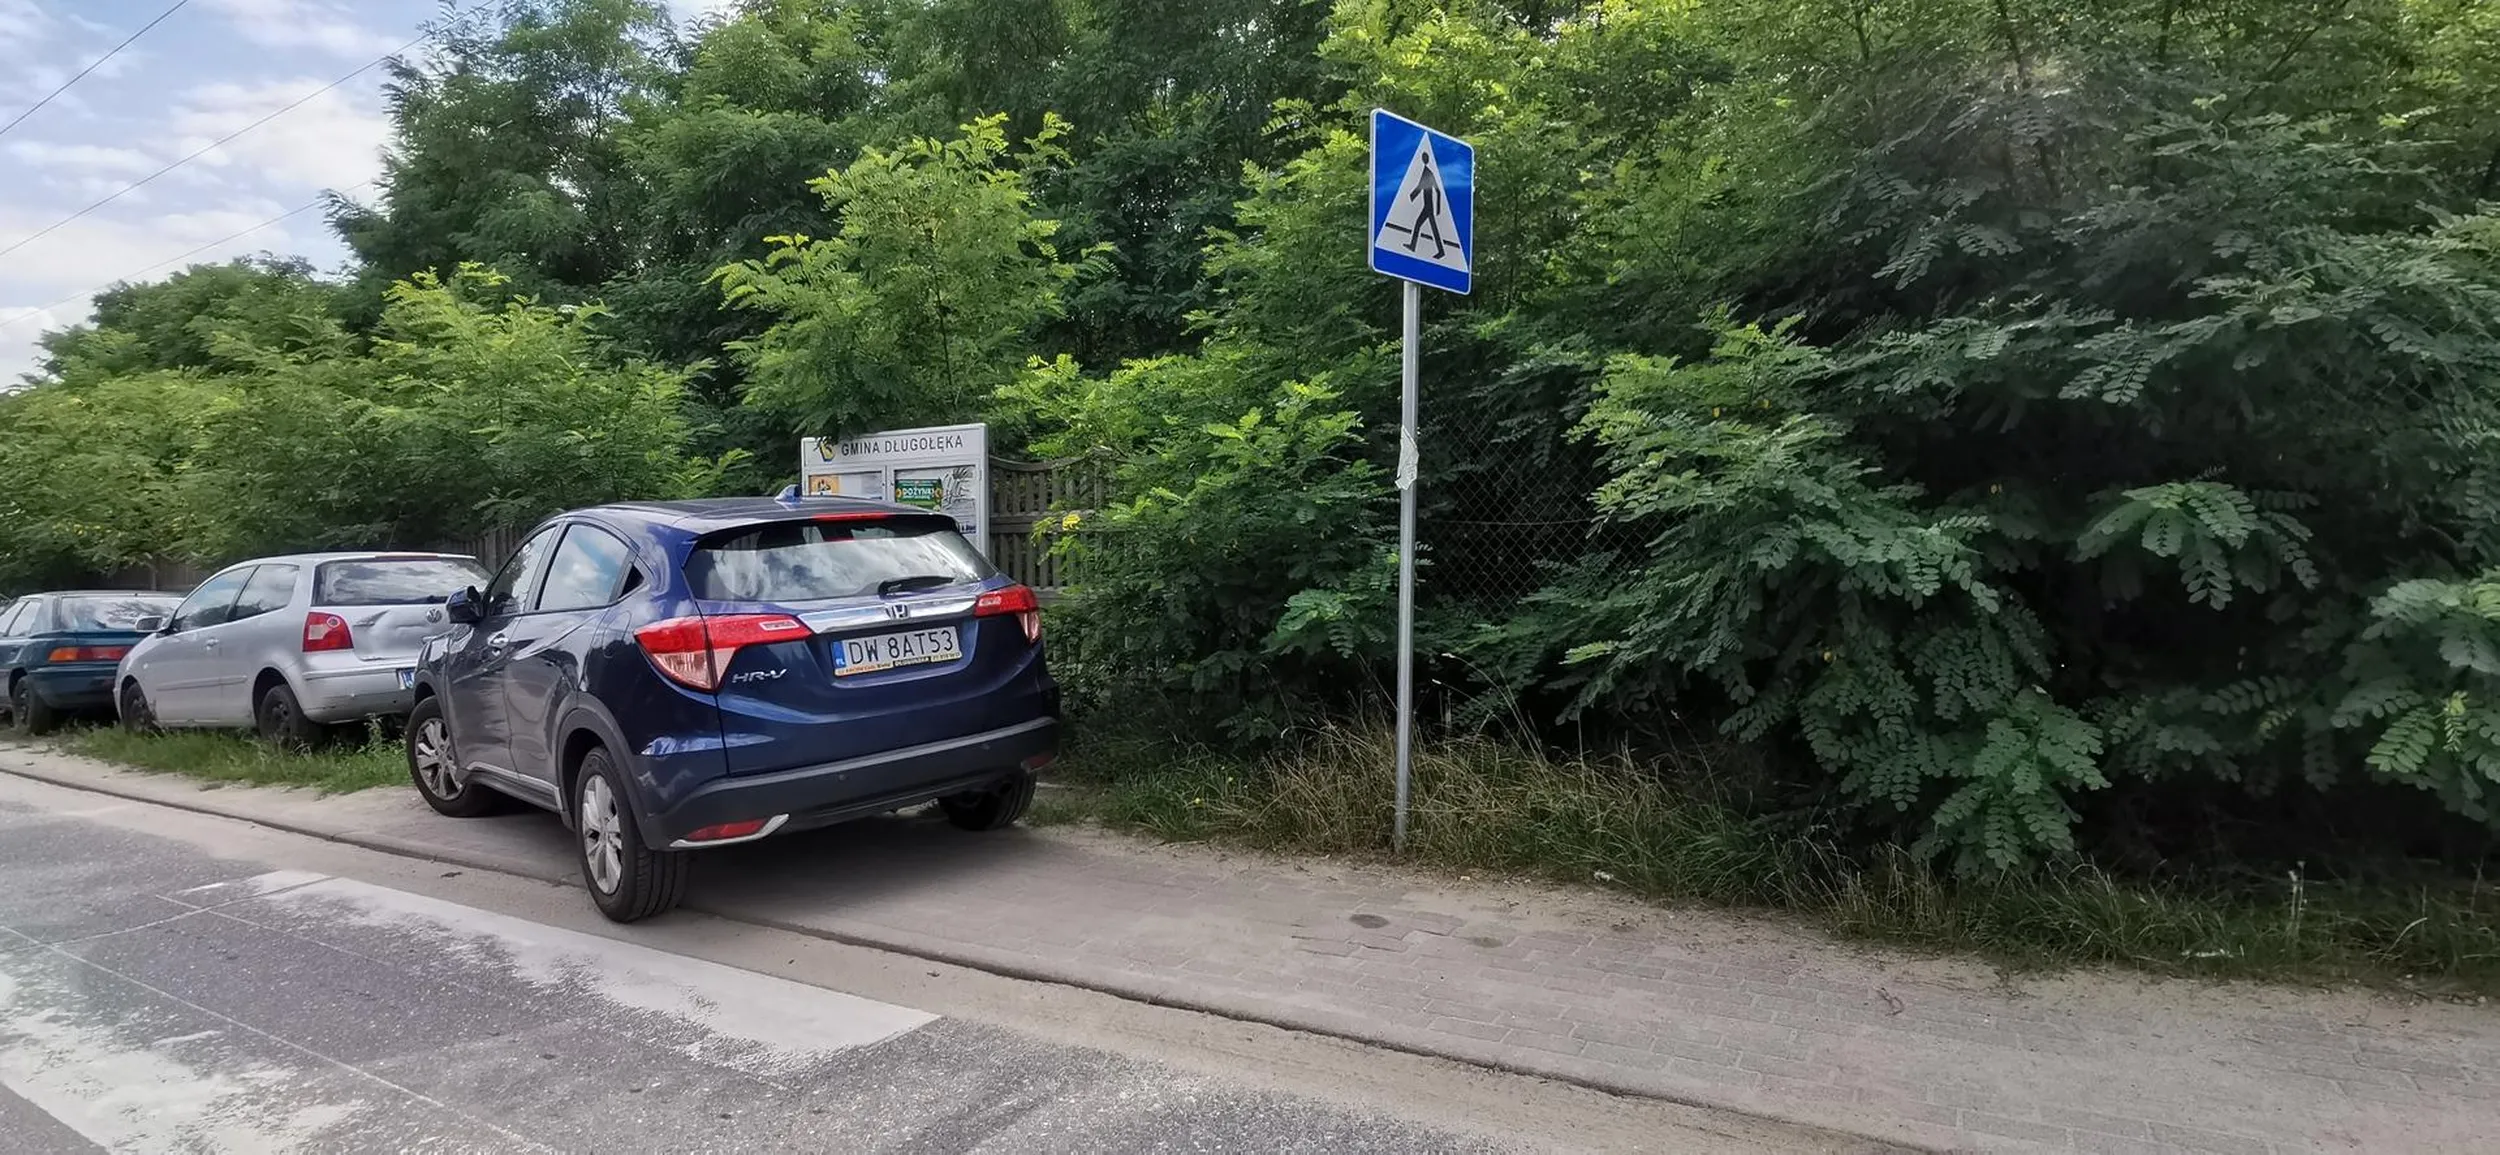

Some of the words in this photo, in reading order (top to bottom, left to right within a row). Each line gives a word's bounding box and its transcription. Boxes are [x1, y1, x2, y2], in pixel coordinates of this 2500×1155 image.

[841, 440, 880, 456] GMINA
[884, 435, 963, 453] DŁUGOŁĘKA
[848, 638, 879, 664] DW
[887, 630, 953, 659] 8AT53
[732, 668, 787, 683] HR-V
